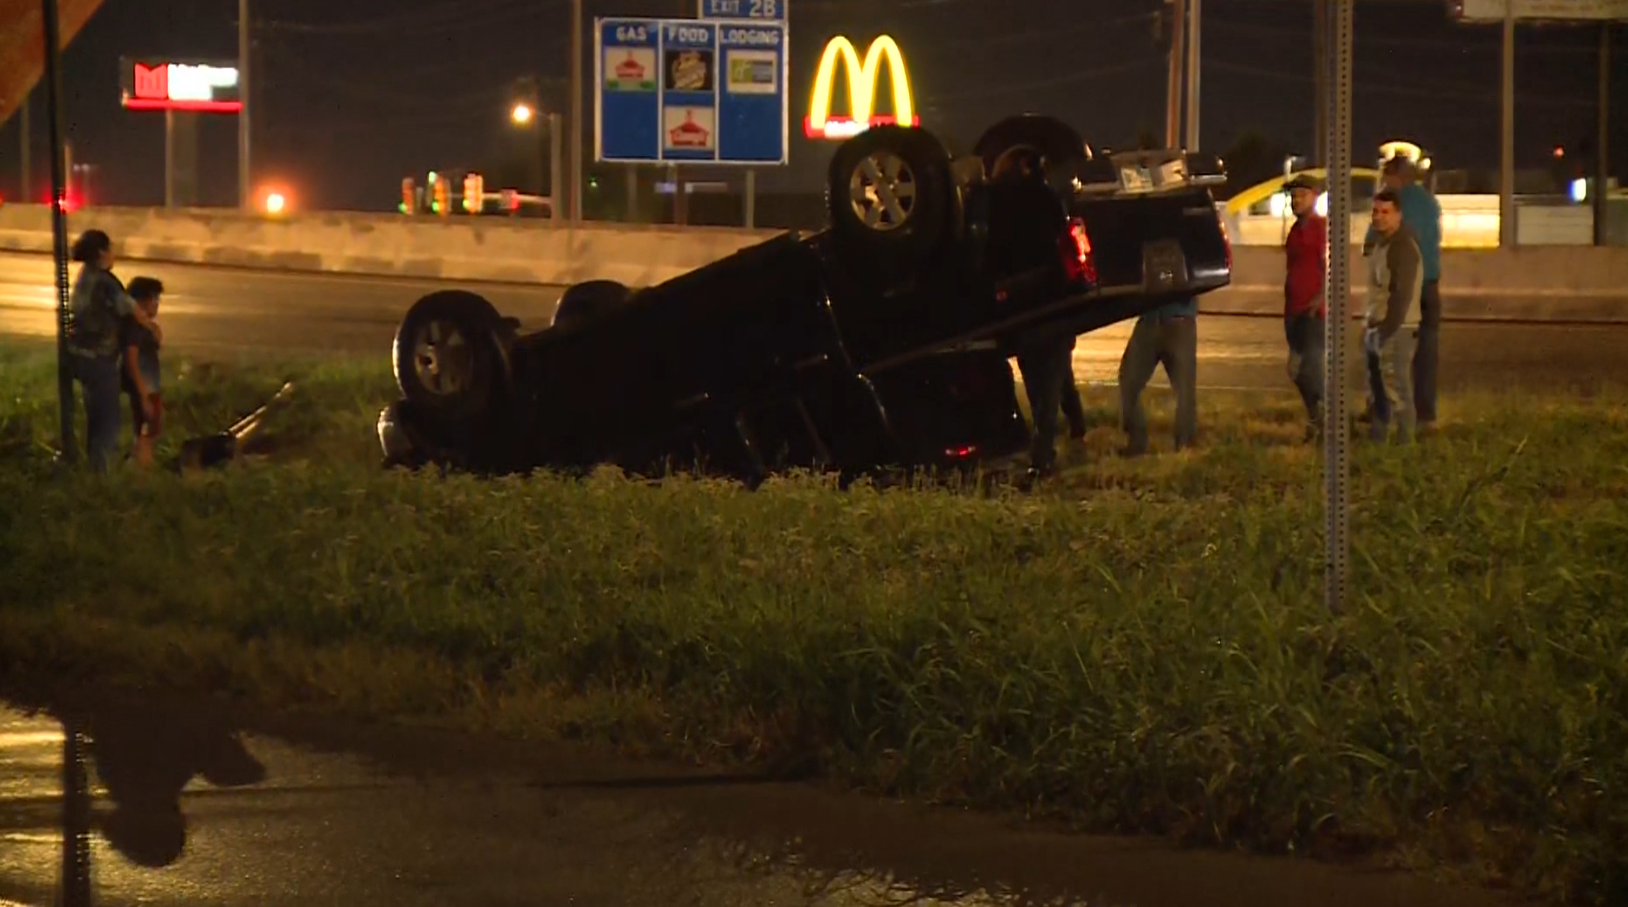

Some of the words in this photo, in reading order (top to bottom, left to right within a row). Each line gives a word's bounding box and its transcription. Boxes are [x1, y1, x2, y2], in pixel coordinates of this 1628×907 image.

[711, 0, 740, 14] EXIT
[749, 0, 776, 17] 2B
[616, 27, 648, 42] GAS
[668, 27, 709, 43] FOOD
[720, 29, 779, 45] LODGING
